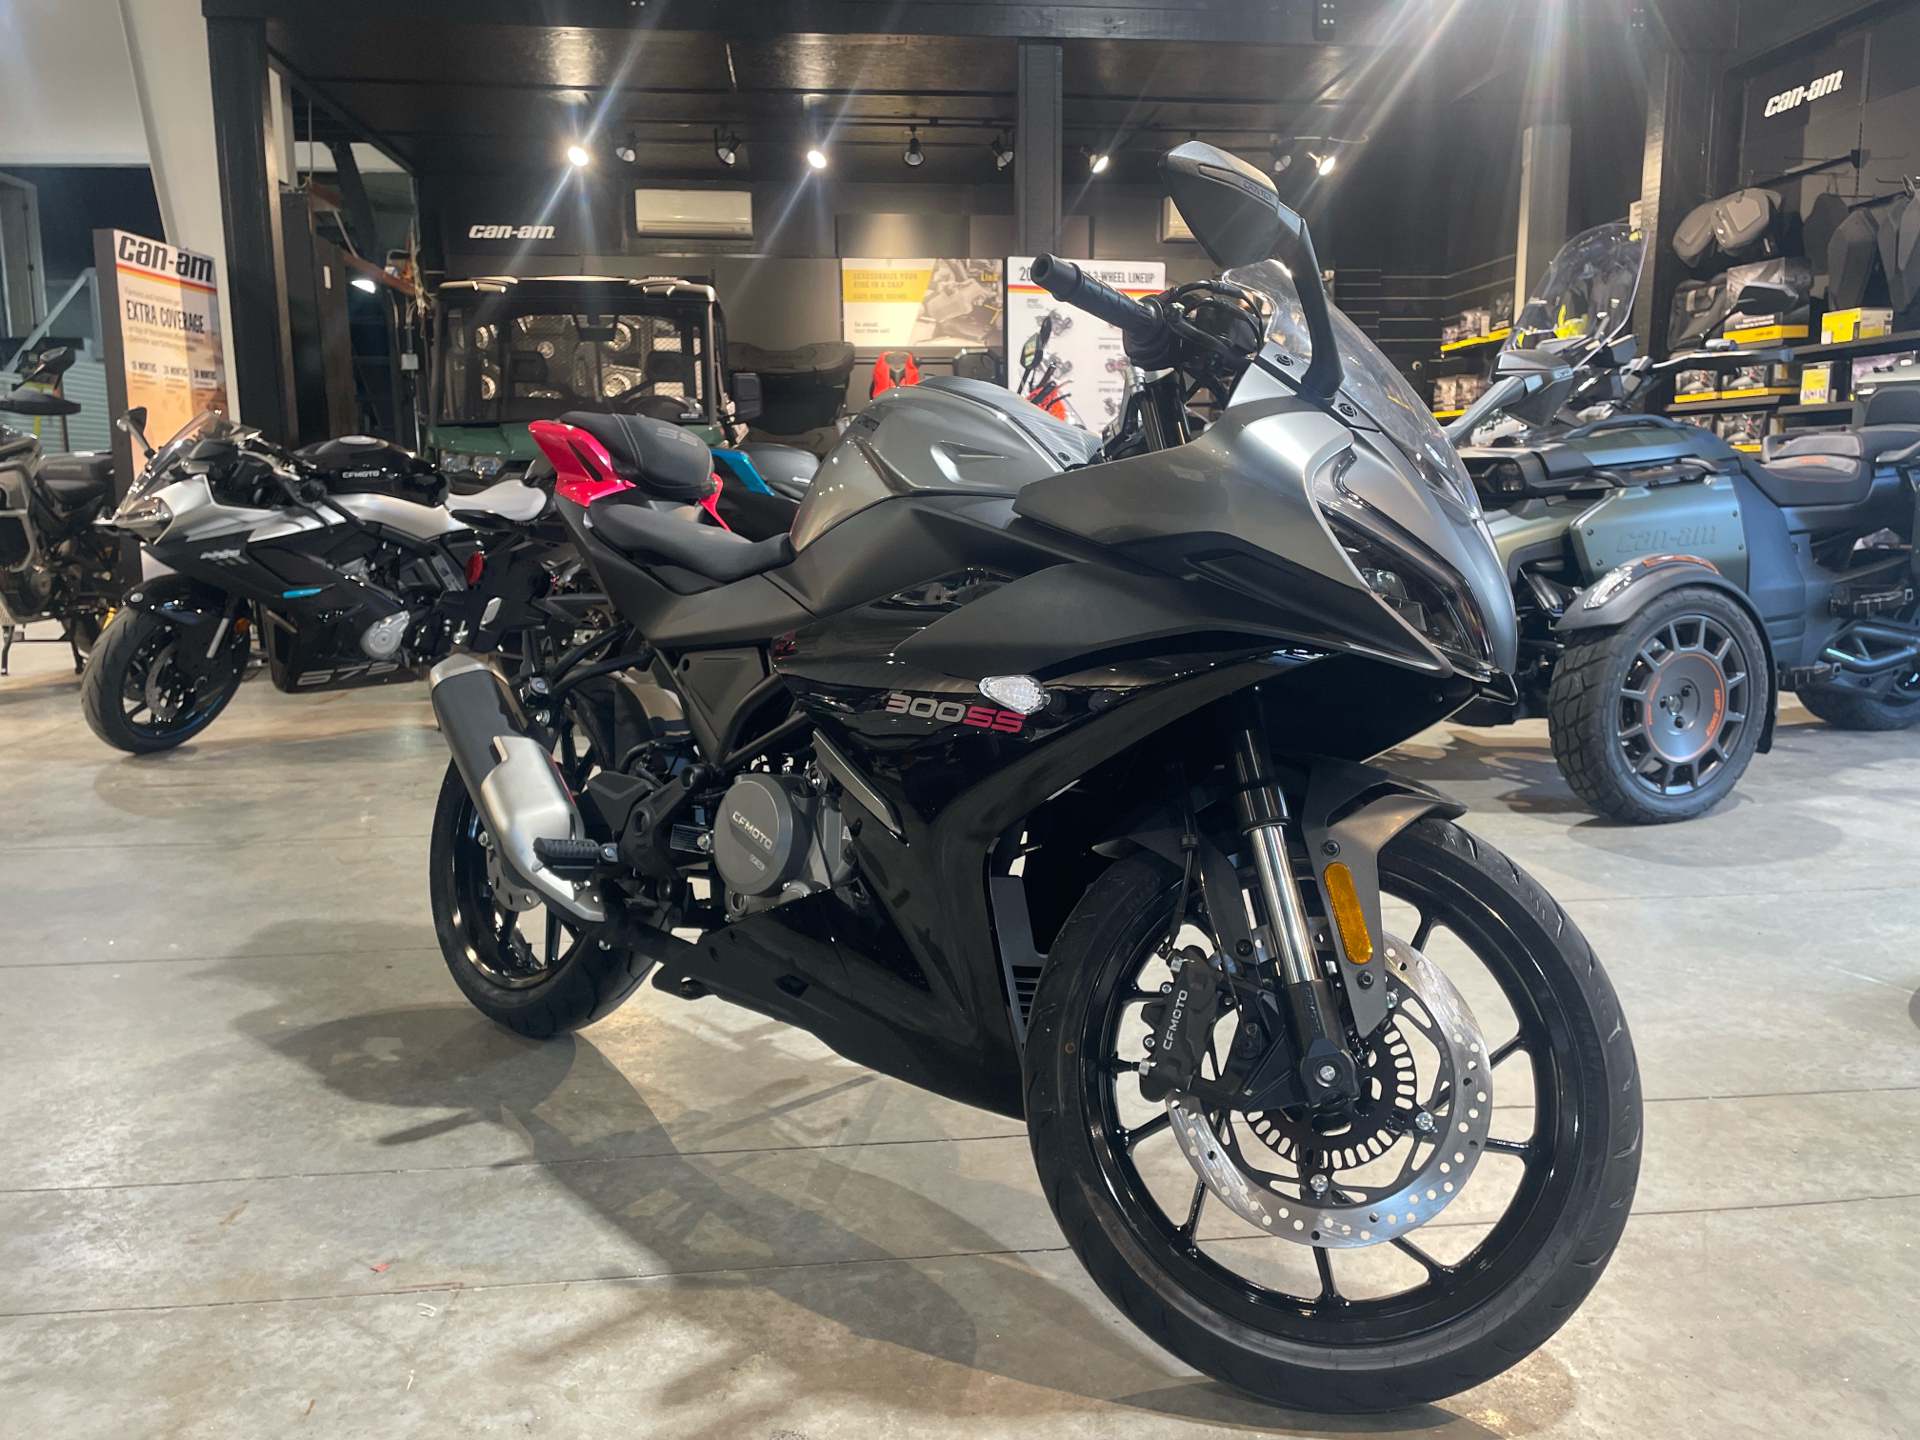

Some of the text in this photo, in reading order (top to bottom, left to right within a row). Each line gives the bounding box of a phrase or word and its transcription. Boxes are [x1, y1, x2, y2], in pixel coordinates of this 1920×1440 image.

[1764, 69, 1843, 118] can-am
[468, 224, 555, 239] can-am
[118, 235, 213, 283] can-am
[1128, 272, 1155, 284] LINEUP
[126, 299, 205, 334] EXTRA COVERAGE
[656, 426, 698, 447] SS
[342, 469, 380, 479] CFMOTO
[1616, 525, 1716, 554] can-am
[731, 810, 773, 851] CFMOTO
[1162, 989, 1188, 1051] CFMOTO
